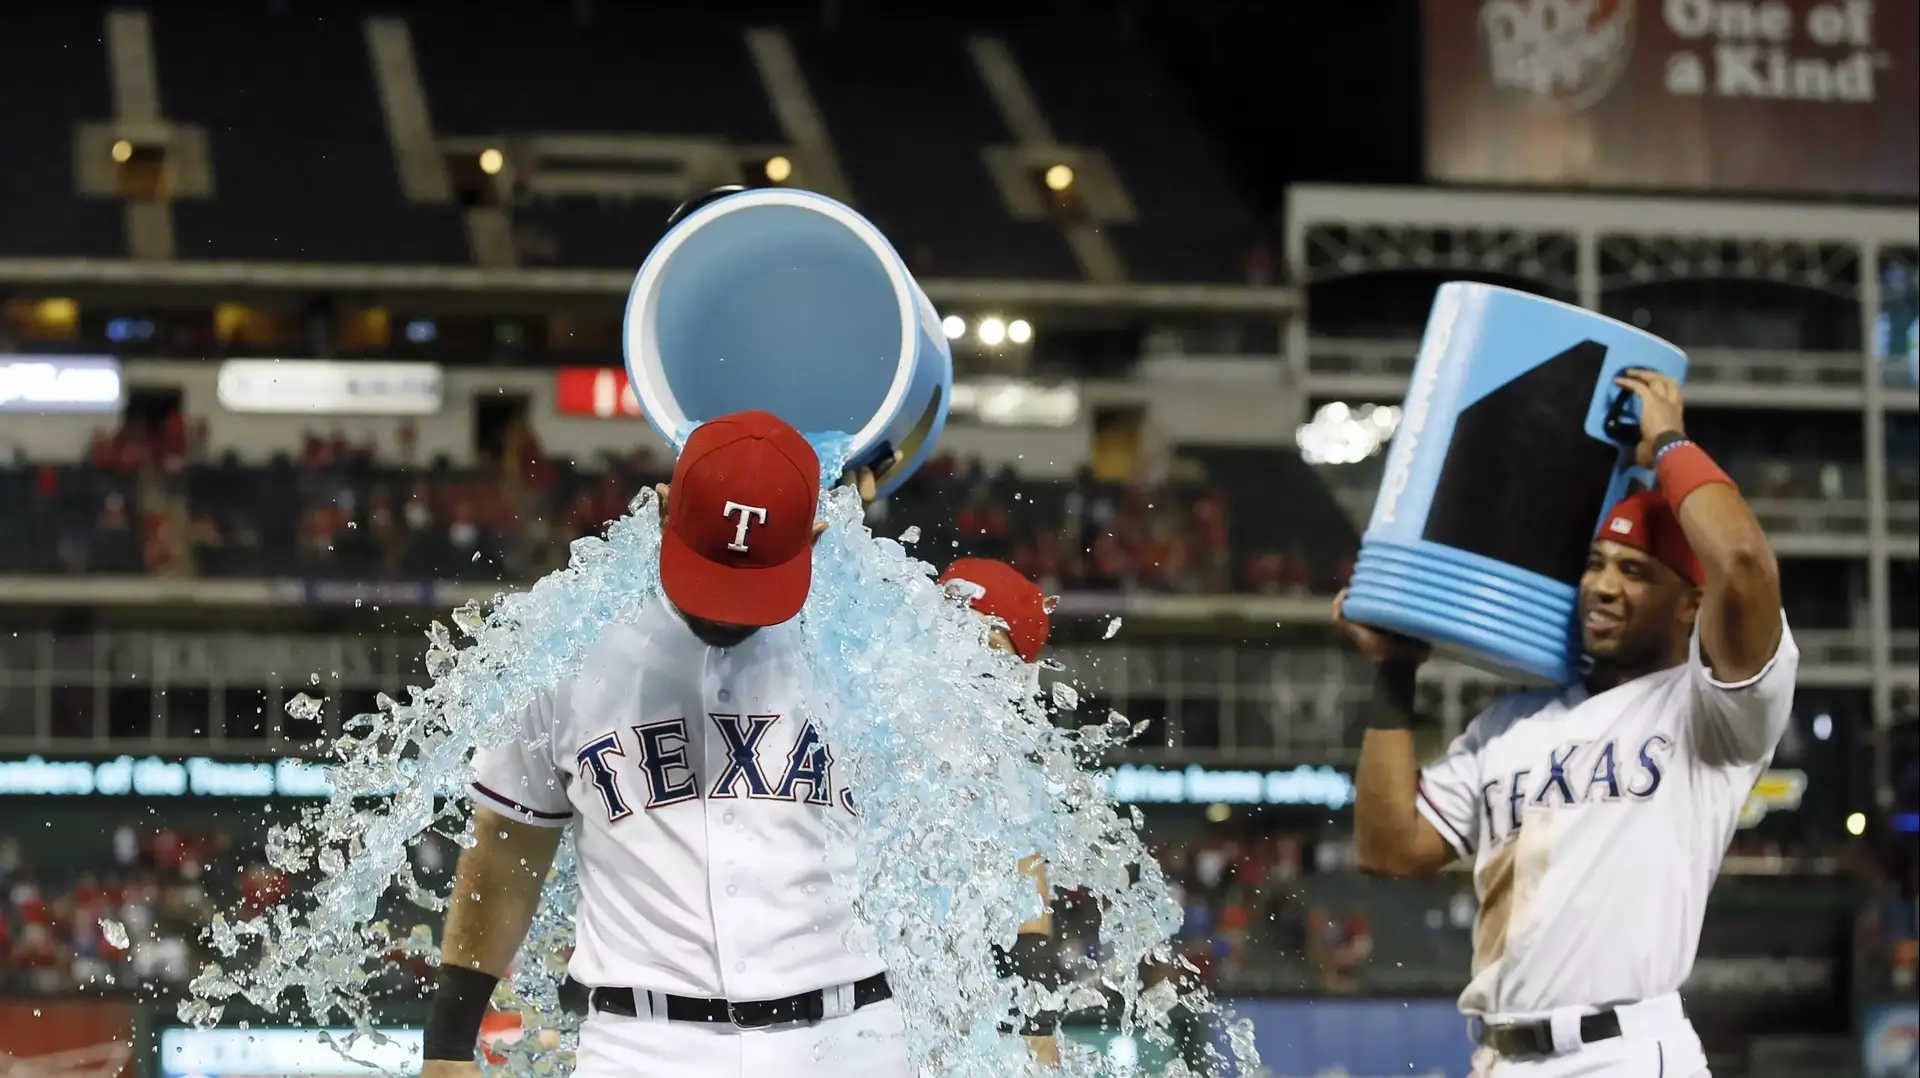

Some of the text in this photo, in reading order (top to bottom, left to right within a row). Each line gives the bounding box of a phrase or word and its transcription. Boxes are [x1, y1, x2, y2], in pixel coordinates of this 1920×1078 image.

[1663, 0, 1872, 46] One of
[1665, 44, 1874, 102] a Kind
[723, 500, 768, 553] T
[576, 713, 865, 822] TEXA
[1481, 735, 1670, 848] TEXAS
